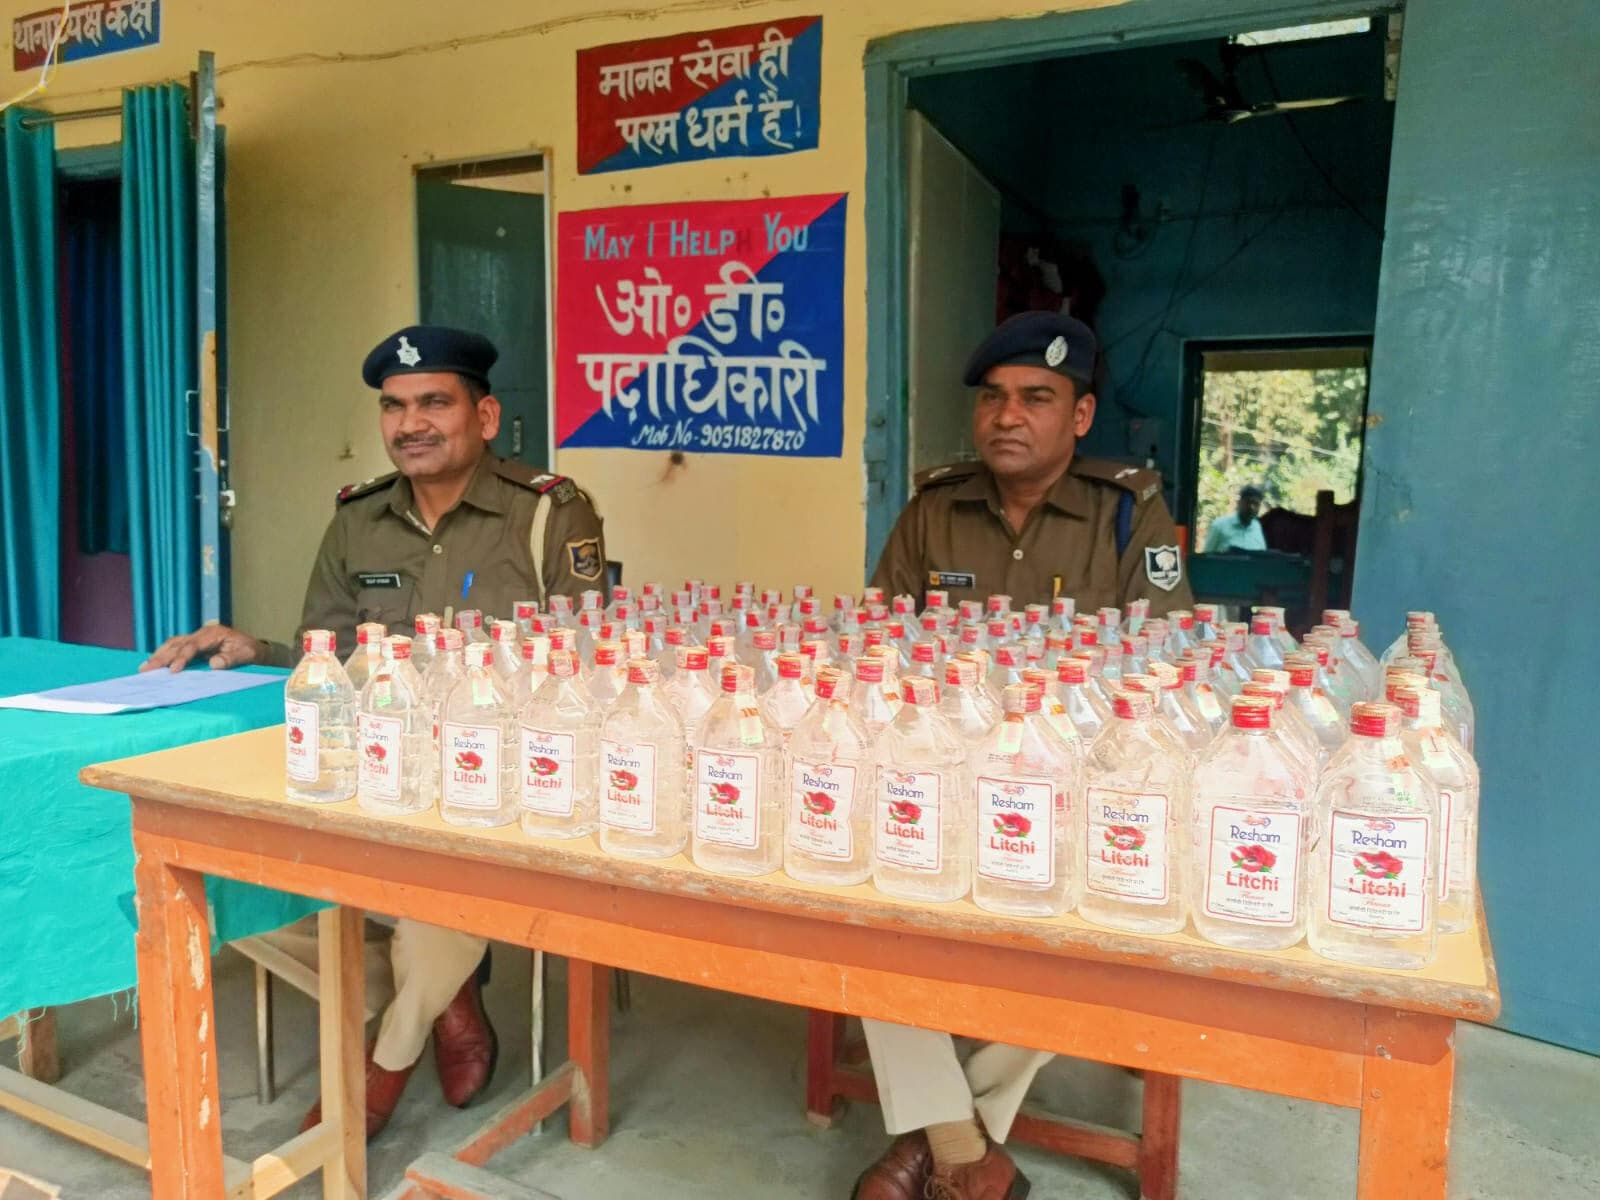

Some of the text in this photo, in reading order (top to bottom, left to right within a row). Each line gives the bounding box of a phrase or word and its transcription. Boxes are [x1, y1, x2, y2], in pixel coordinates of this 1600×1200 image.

[106, 0, 155, 39] कक्ष
[599, 27, 793, 100] मानव सेवा ही
[615, 112, 681, 156] परम
[686, 89, 754, 152] धर्म
[647, 221, 655, 257] I
[631, 424, 669, 446] Mob
[700, 424, 806, 451] 9031827870
[454, 737, 486, 750] Resham
[528, 741, 560, 756] Resham
[607, 753, 641, 768] Resham
[453, 770, 488, 785] Litchi
[527, 775, 563, 789] Litchi
[708, 765, 743, 781] Resham
[803, 773, 840, 792] Resham
[887, 782, 924, 799] Resham
[607, 789, 641, 806] Litchi
[992, 794, 1034, 811] Resham
[706, 803, 744, 820] Litchi
[1103, 806, 1149, 823] Resham
[799, 811, 837, 832] Litchi
[885, 822, 925, 840] Litchi
[1230, 825, 1281, 843] Resham
[1351, 830, 1407, 849] Resham
[990, 836, 1036, 855] Litchi
[1101, 849, 1149, 867] Litchi
[1226, 871, 1279, 891] Litchi
[1348, 877, 1407, 898] Litchi
